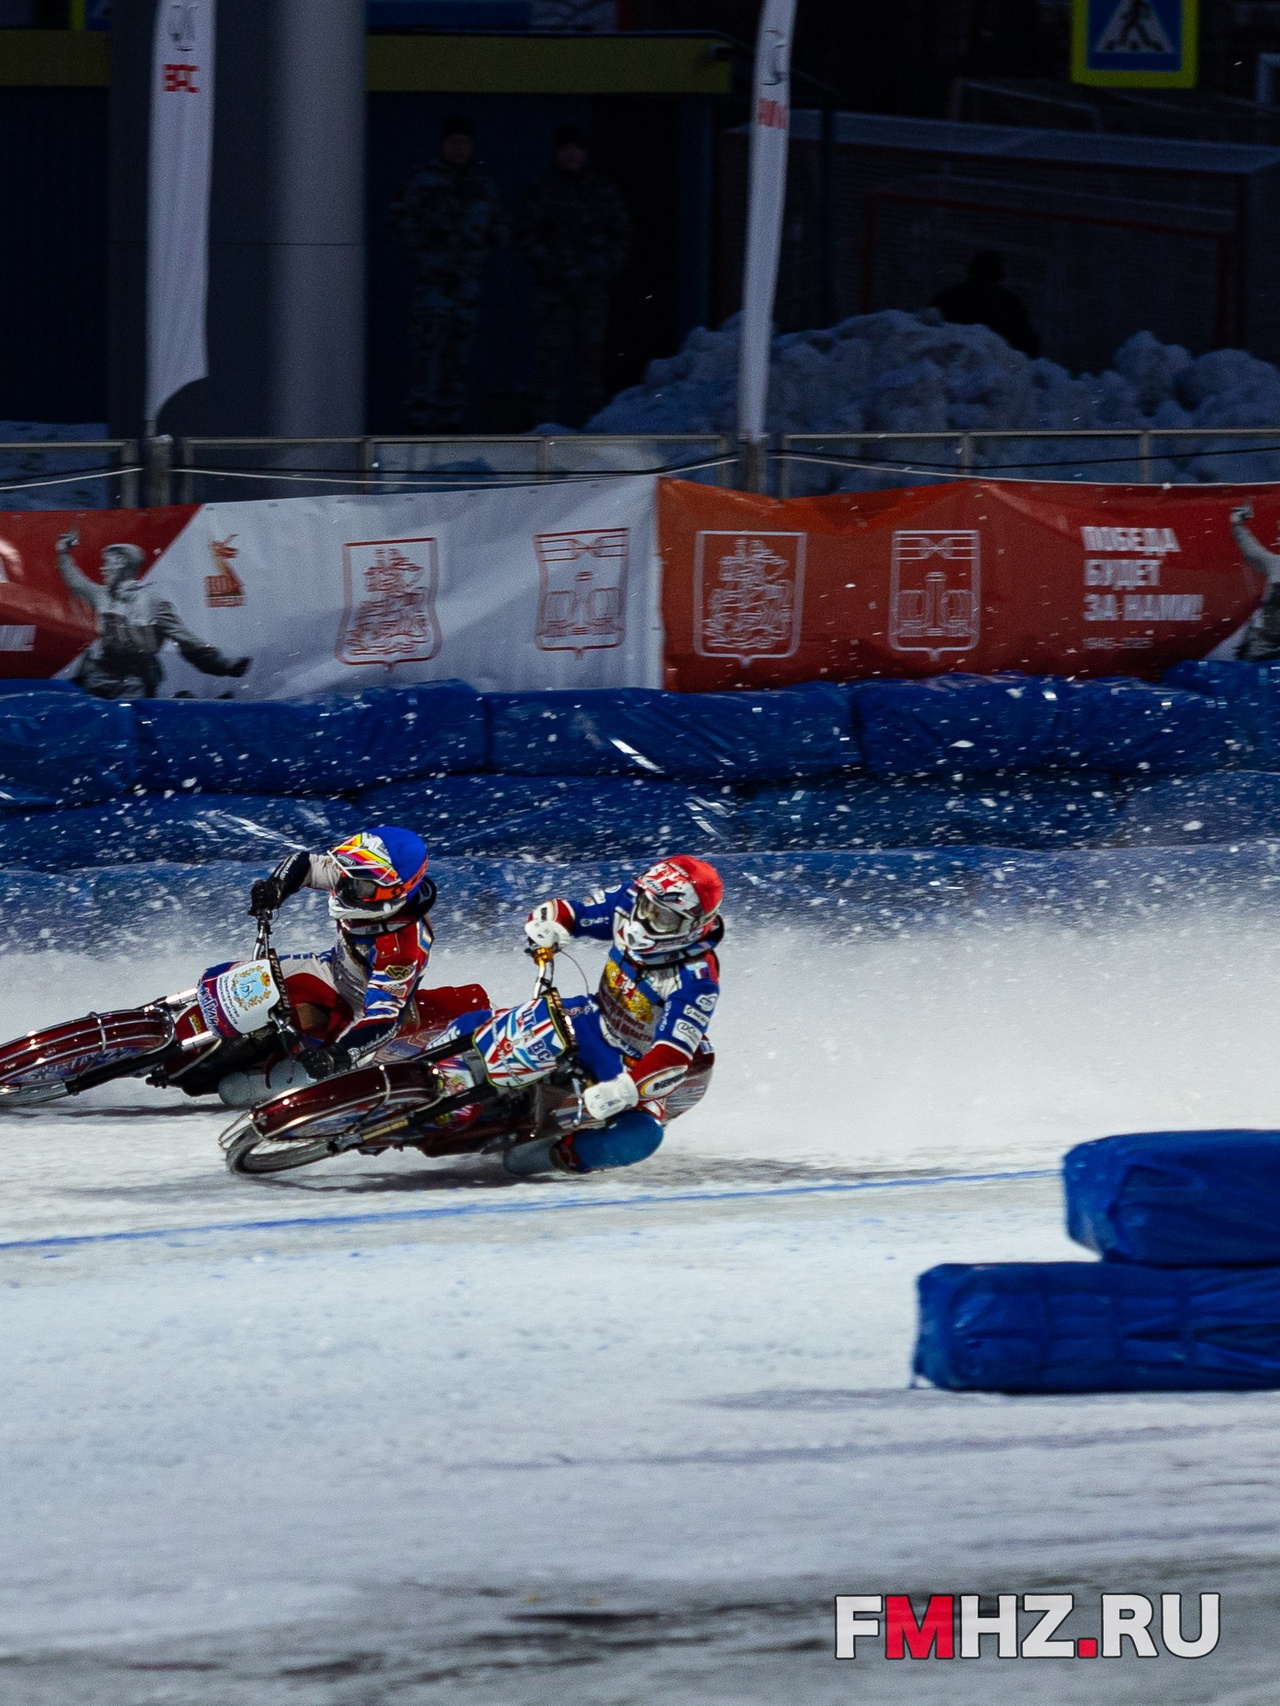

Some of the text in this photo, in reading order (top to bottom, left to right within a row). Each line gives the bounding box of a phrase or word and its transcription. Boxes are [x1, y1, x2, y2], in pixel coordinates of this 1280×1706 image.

[1080, 526, 1181, 556] ПОБЕДА
[1084, 559, 1163, 590] БУДЕТ
[1083, 593, 1119, 621] ЗА
